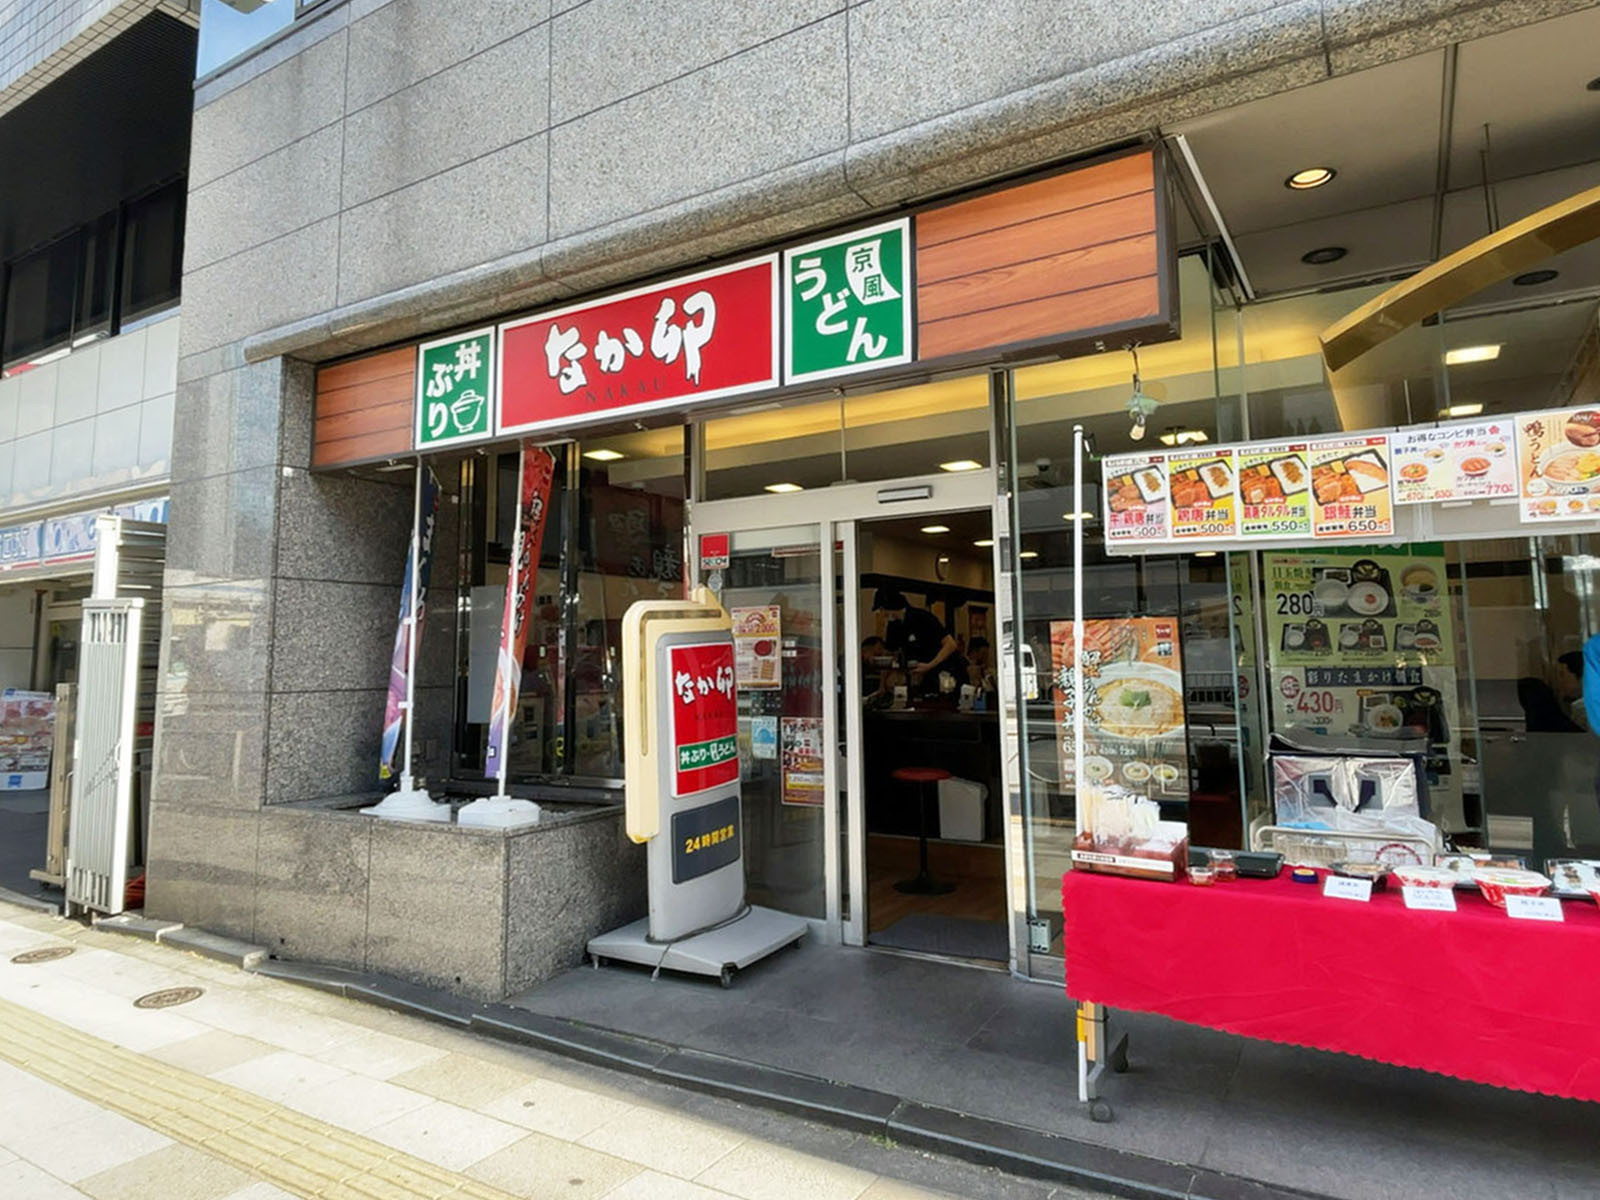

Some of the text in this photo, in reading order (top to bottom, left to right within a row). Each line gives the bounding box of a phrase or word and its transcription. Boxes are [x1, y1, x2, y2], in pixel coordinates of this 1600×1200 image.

[794, 257, 888, 363] うどん
[851, 245, 884, 299] 京風
[426, 342, 482, 438] 丼ぶり
[544, 290, 717, 395] なか卯
[675, 666, 734, 704] なか卯
